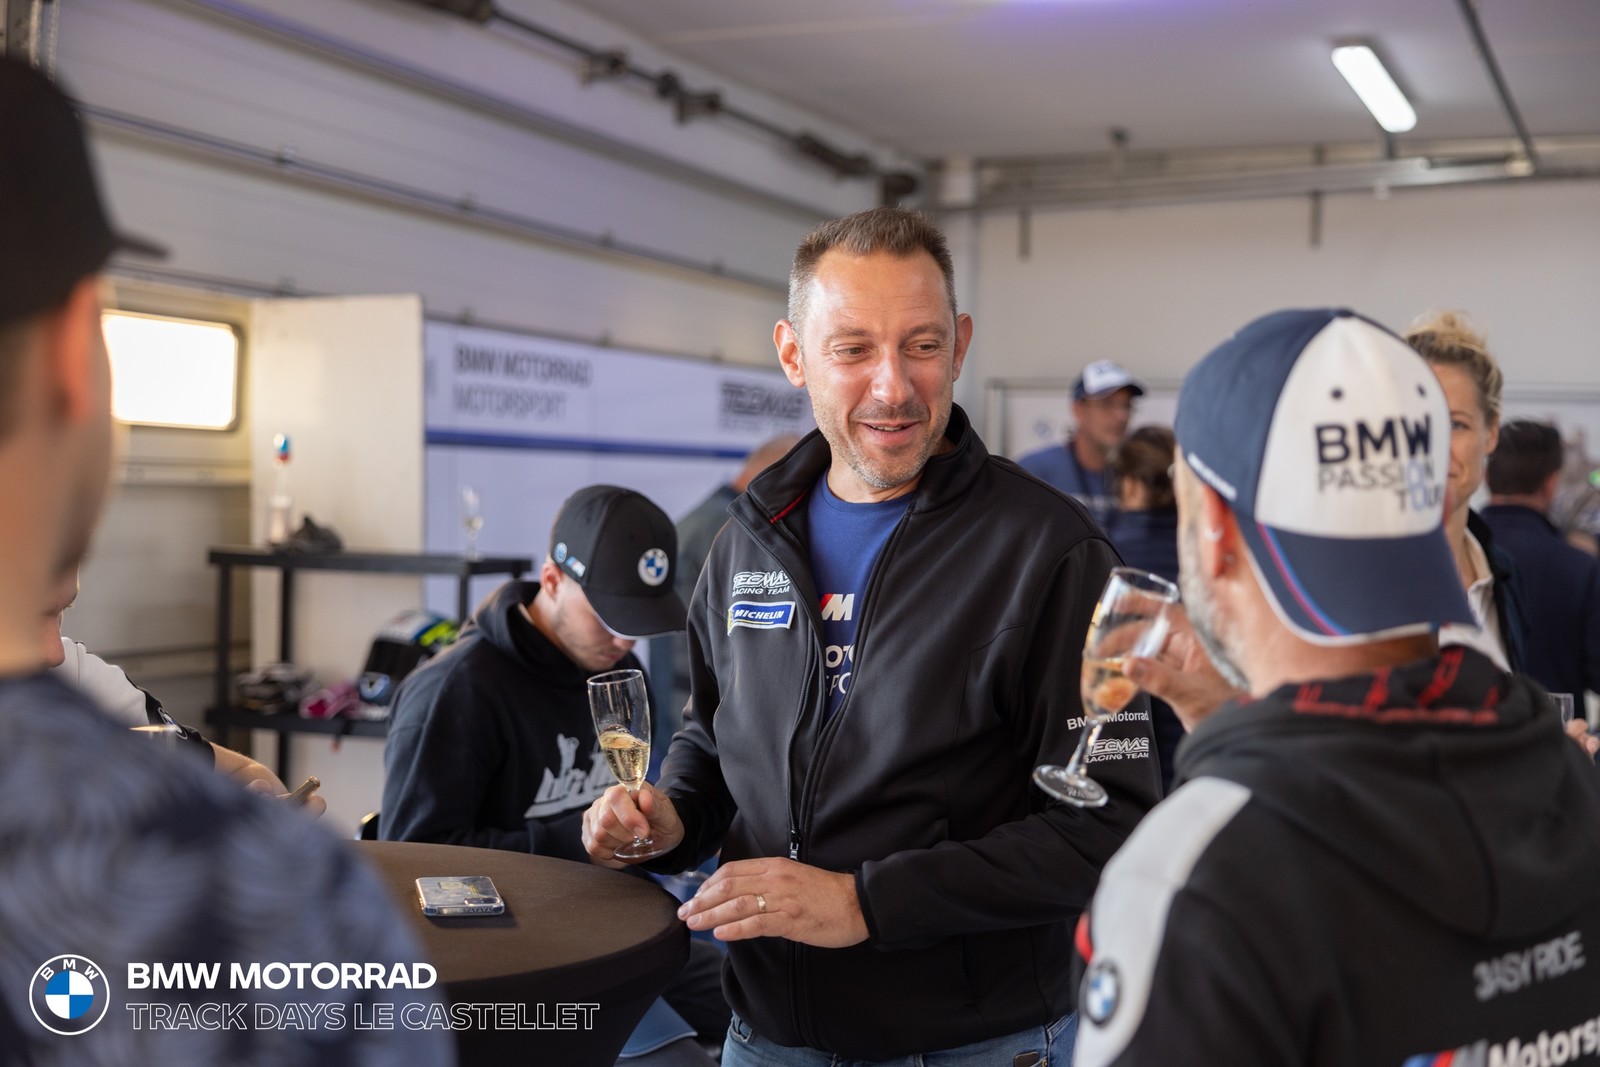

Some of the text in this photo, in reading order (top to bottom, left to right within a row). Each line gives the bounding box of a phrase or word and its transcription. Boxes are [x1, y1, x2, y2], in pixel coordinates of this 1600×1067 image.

[1315, 413, 1430, 465] BMW
[1317, 457, 1435, 495] PASSION
[767, 586, 790, 596] TEAM
[734, 609, 785, 620] MICHELIN
[1066, 716, 1089, 731] BM
[1088, 737, 1150, 757] ECMAS
[1488, 1014, 1600, 1067] Motors
